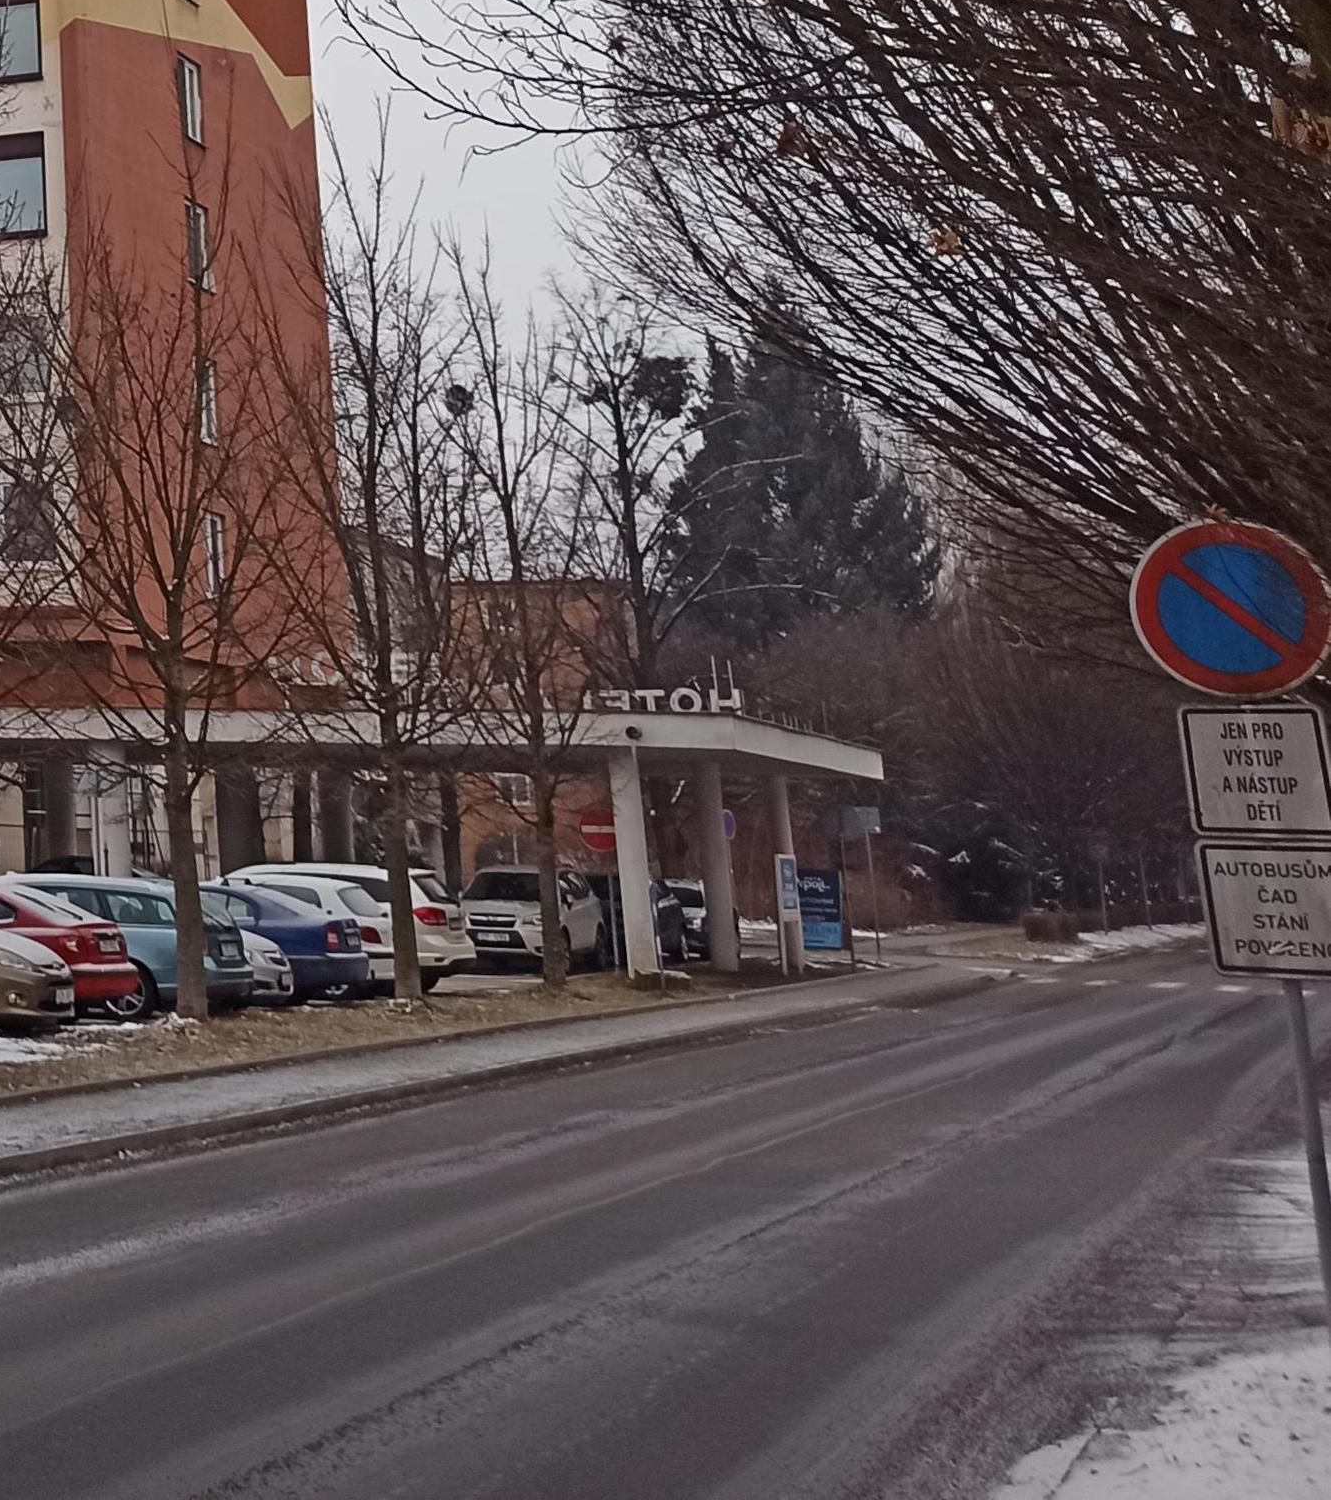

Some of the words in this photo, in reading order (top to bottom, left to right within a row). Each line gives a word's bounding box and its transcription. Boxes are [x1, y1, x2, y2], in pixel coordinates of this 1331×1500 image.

[1220, 722, 1248, 740] JEN
[1251, 722, 1284, 740] PRO
[1223, 745, 1283, 767] VÝSTUP
[1222, 775, 1233, 793] A
[1236, 772, 1298, 795] NÁSTUP
[1246, 800, 1282, 821] DĚTÍ
[1214, 859, 1331, 879] AUTOBUSŮM
[1257, 885, 1298, 904] ČAD
[1253, 911, 1310, 931] STÁNÍ
